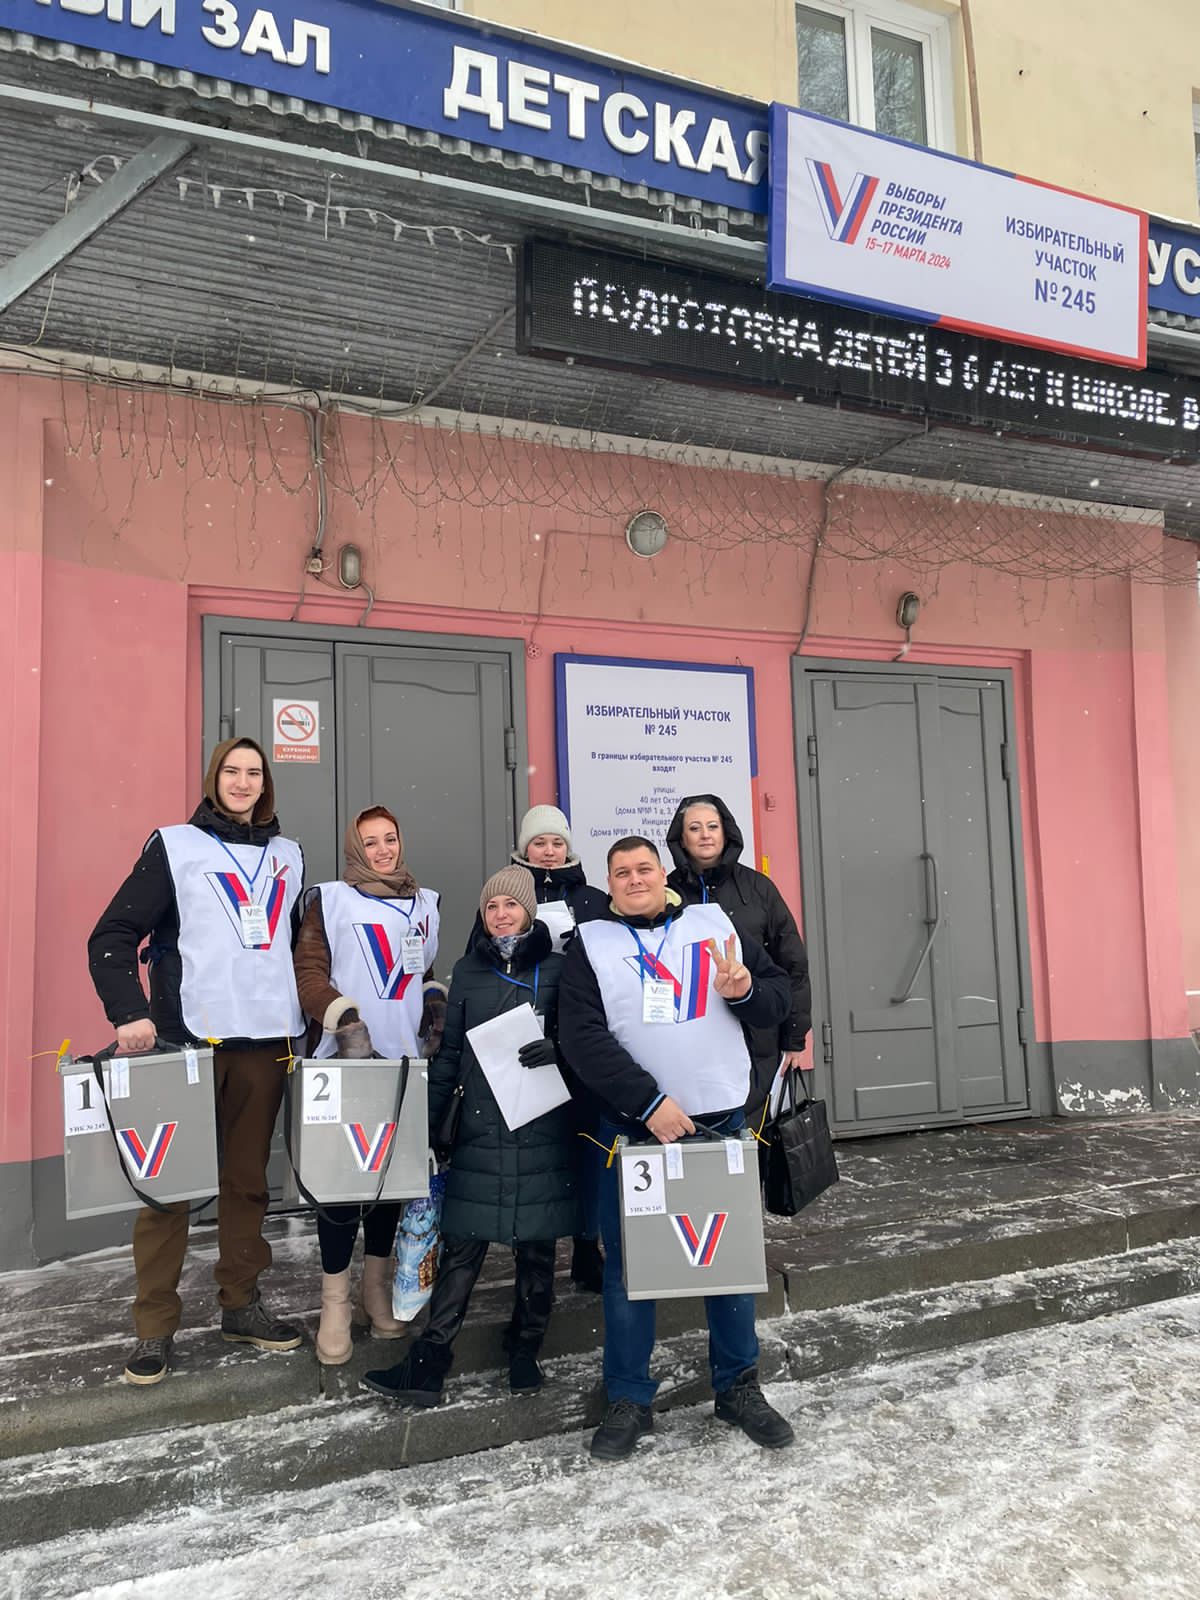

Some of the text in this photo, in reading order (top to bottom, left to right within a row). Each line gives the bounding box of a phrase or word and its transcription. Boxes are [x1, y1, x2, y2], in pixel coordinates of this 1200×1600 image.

[201, 0, 331, 74] ЗАЛ
[886, 182, 947, 211] ВЫБОРЫ
[870, 219, 928, 246] РОССИИ
[878, 200, 963, 236] ПРЕЗИДЕНТА
[1005, 215, 1124, 264] ИЗБИРАТЕЛЬНЫЙ
[895, 245, 927, 264] МАРТА
[927, 253, 952, 270] 2024
[1034, 249, 1097, 281] УЧАСТОК
[572, 276, 824, 362] ПОДГОТОВКА
[826, 327, 927, 382] ДЕТЕЙ
[986, 360, 1041, 401] ЛЕТ
[1071, 375, 1176, 426] ШКОЛЕ
[586, 704, 731, 723] ИЗБИРАТЕЛЬНЫЙ УЧАСТОК
[658, 725, 678, 737] 245
[597, 752, 629, 762] границы
[629, 753, 683, 763] избирательного
[684, 755, 711, 764] участка
[720, 755, 733, 763] 245
[652, 766, 676, 774] входят
[77, 1077, 96, 1111] 1
[312, 1071, 331, 1102] 2
[632, 1159, 653, 1193] 3
